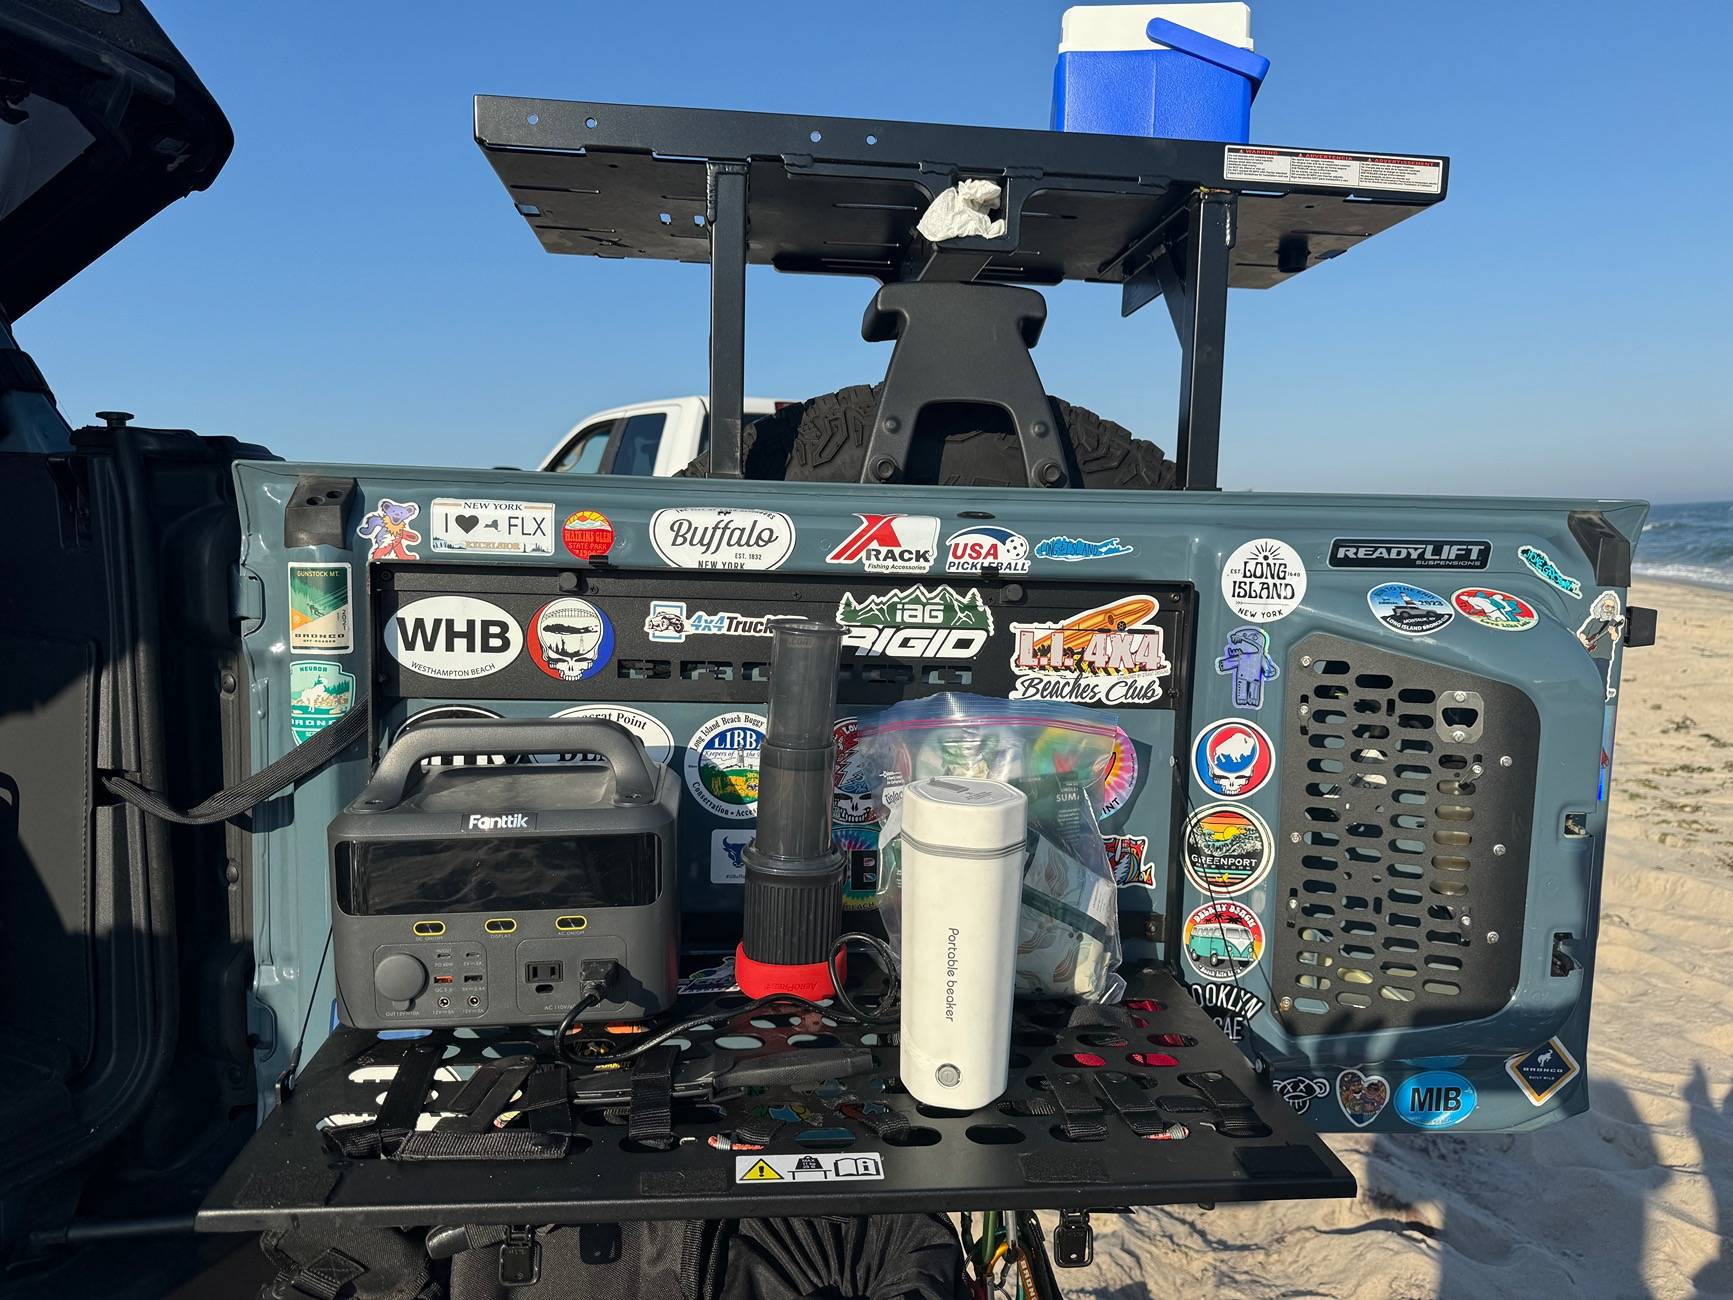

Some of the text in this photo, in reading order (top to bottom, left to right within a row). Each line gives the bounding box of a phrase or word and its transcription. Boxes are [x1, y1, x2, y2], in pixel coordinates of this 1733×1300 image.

[507, 516, 546, 536] FLX
[564, 530, 612, 543] WATKINS GLEN
[669, 518, 779, 555] Buffalo
[866, 549, 931, 562] RACK
[951, 543, 999, 560] USA
[1337, 545, 1485, 560] READYLIFT
[698, 560, 746, 570] NEW YORK
[1242, 560, 1287, 580] LONG
[1231, 580, 1295, 600] ISLAND
[1237, 607, 1283, 618] NEW YORK
[1386, 615, 1402, 628] LONG
[690, 612, 774, 635] 4x4Truck
[397, 617, 511, 653] WHB
[840, 627, 990, 659] RIGID
[300, 665, 328, 673] NEVADA
[411, 661, 496, 677] WESTHAMPTON BEACH
[1021, 674, 1102, 700] Beaches
[1105, 679, 1160, 702] Club
[616, 712, 648, 730] Point
[842, 724, 859, 735] LOV
[689, 714, 765, 752] Long Island Beach Buggy
[714, 729, 761, 749] LIBB
[704, 750, 727, 759] Keepers
[691, 780, 729, 816] Conservation
[1102, 797, 1120, 815] INT
[468, 814, 528, 830] Fanttik
[1191, 854, 1258, 867] GREENPORT
[945, 927, 960, 1022] Portable beaker
[1192, 984, 1258, 1020] OOKLYN
[1410, 1087, 1462, 1112] MIB
[1020, 1259, 1039, 1300] BRON
